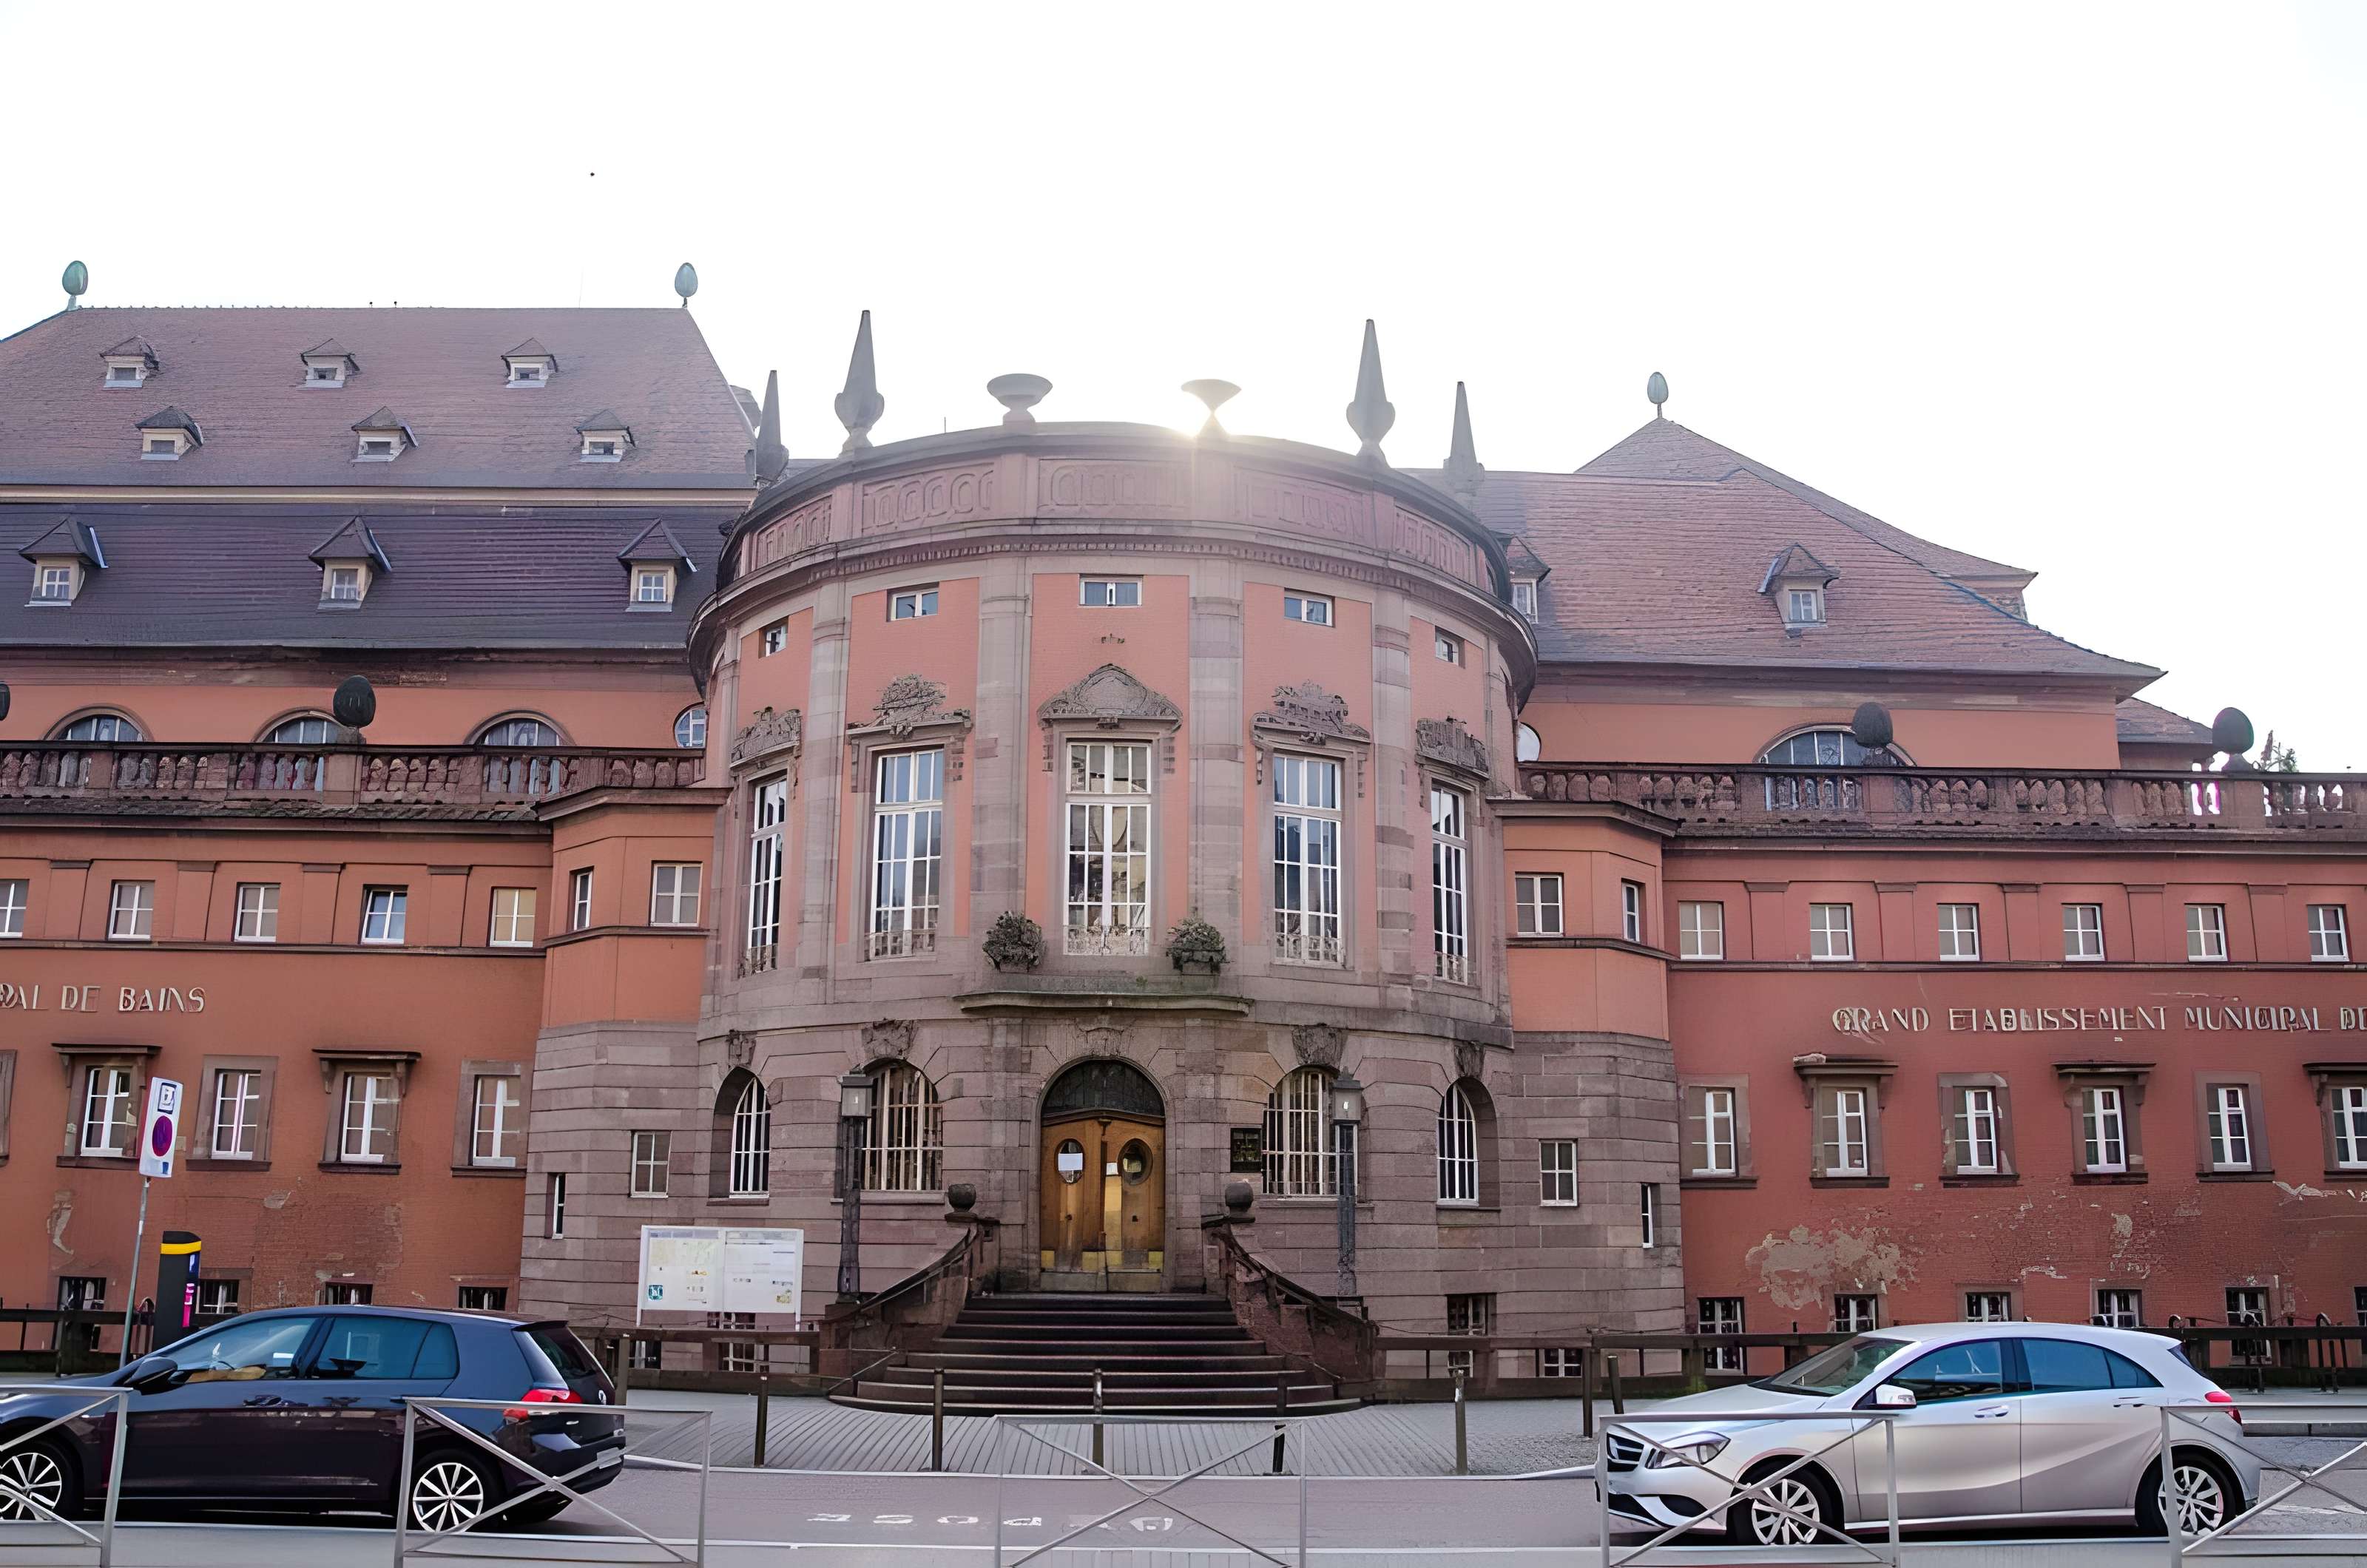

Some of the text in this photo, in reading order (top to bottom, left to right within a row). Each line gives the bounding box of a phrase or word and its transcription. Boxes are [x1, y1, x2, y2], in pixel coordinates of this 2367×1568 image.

[61, 985, 100, 1012] DE
[118, 987, 206, 1013] BAINS
[1832, 1007, 1929, 1037] GRAND
[1949, 1006, 2167, 1031] ETABLISSEMENT
[2184, 1006, 2331, 1031] MUNICIPAL
